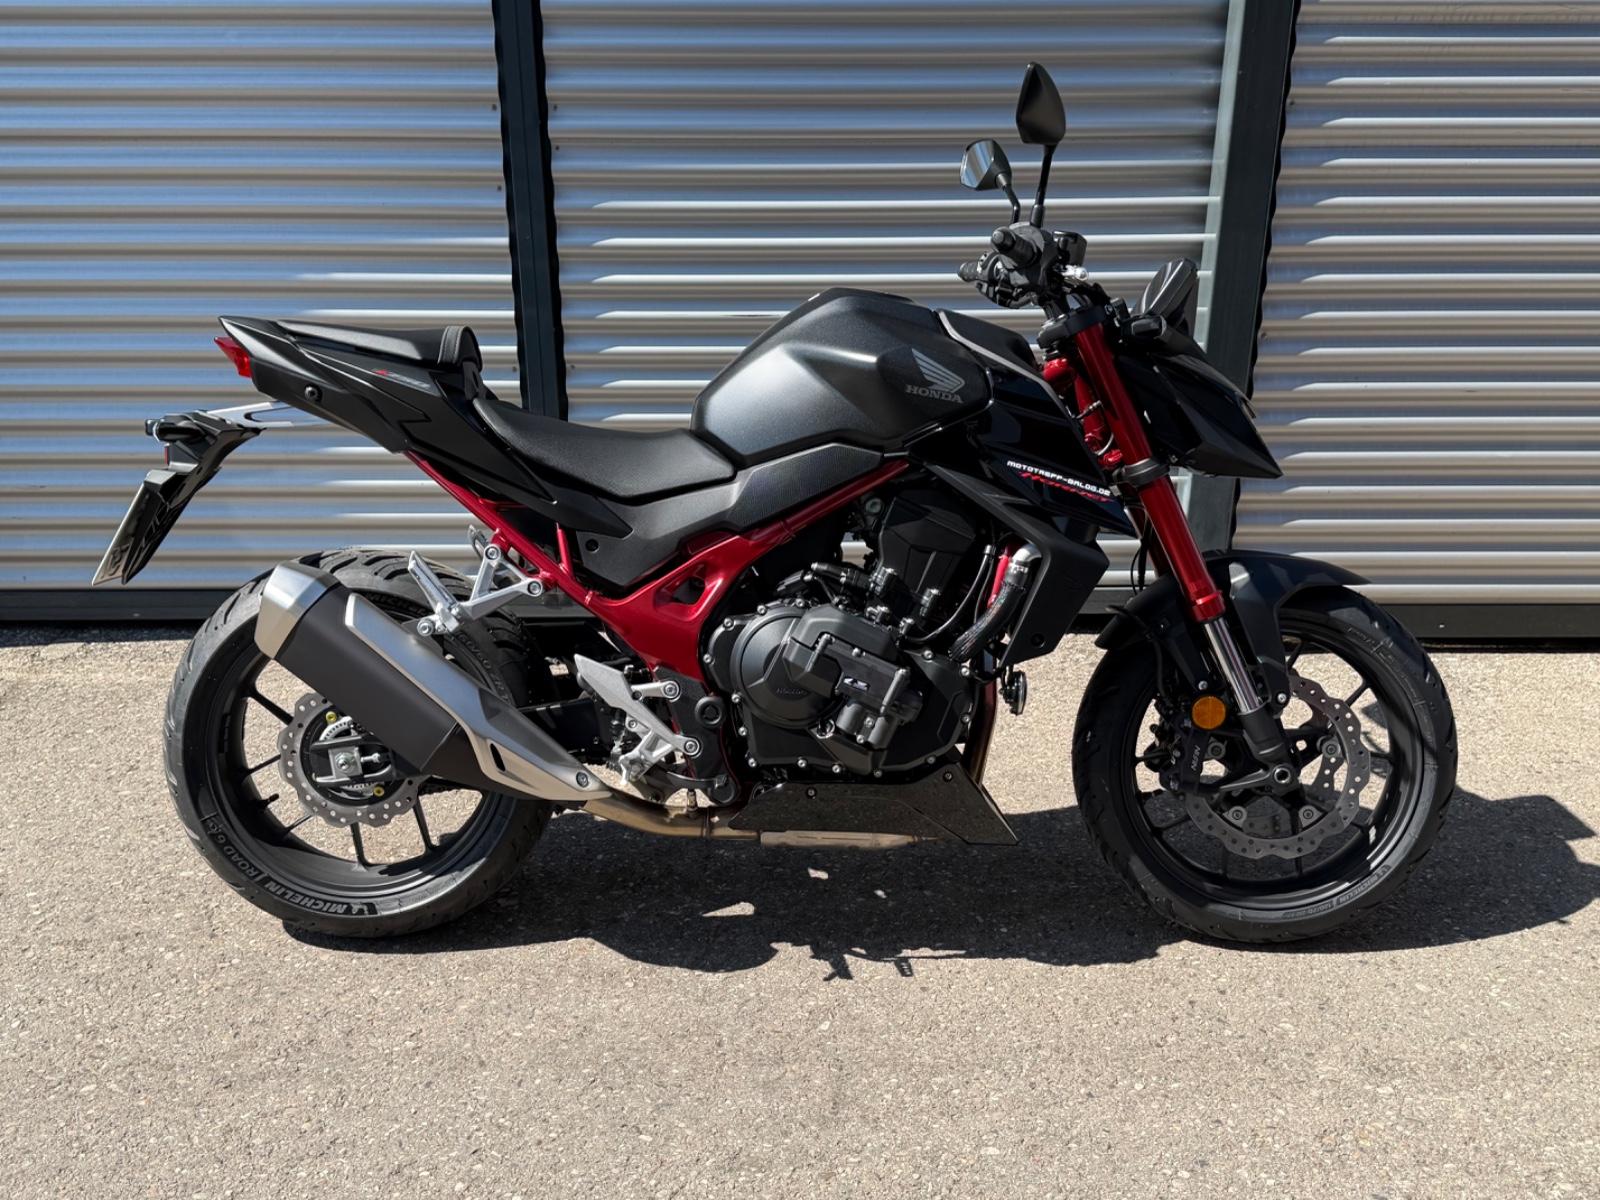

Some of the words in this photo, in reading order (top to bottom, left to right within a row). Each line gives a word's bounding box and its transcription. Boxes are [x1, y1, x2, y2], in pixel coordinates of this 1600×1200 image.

[905, 384, 963, 404] HONDA
[223, 844, 259, 880] ROAD
[264, 881, 348, 914] MICHELIN
